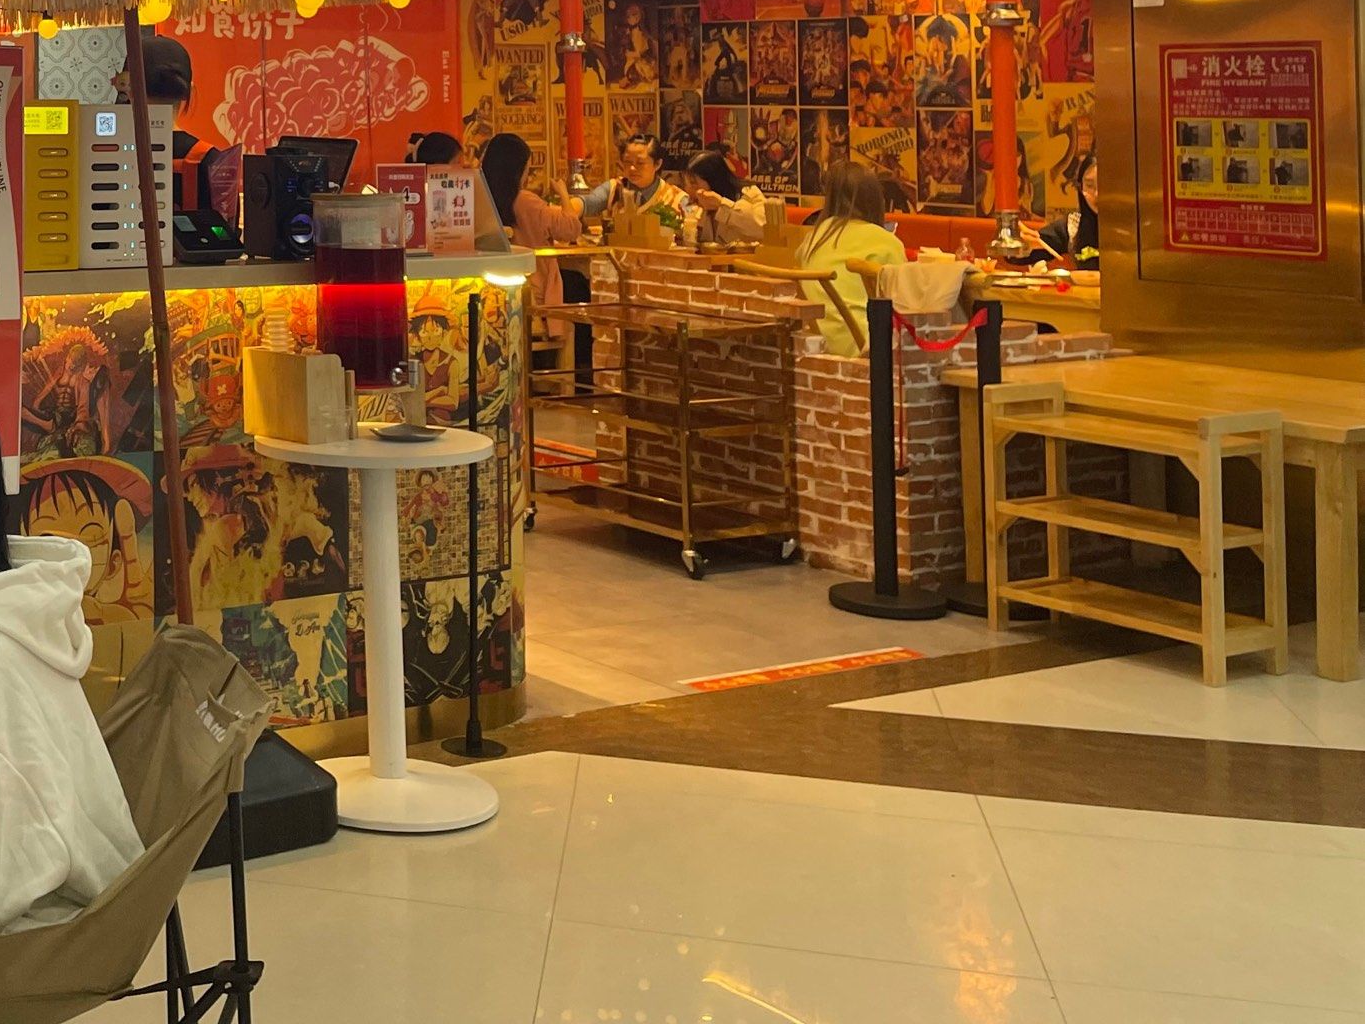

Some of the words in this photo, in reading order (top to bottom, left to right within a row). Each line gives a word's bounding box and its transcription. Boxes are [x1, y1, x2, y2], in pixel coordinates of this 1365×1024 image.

[441, 50, 450, 70] Eat
[495, 48, 545, 64] WANTED
[1201, 55, 1266, 77] 消火栓
[441, 74, 451, 103] Meat
[610, 97, 656, 113] WANTED
